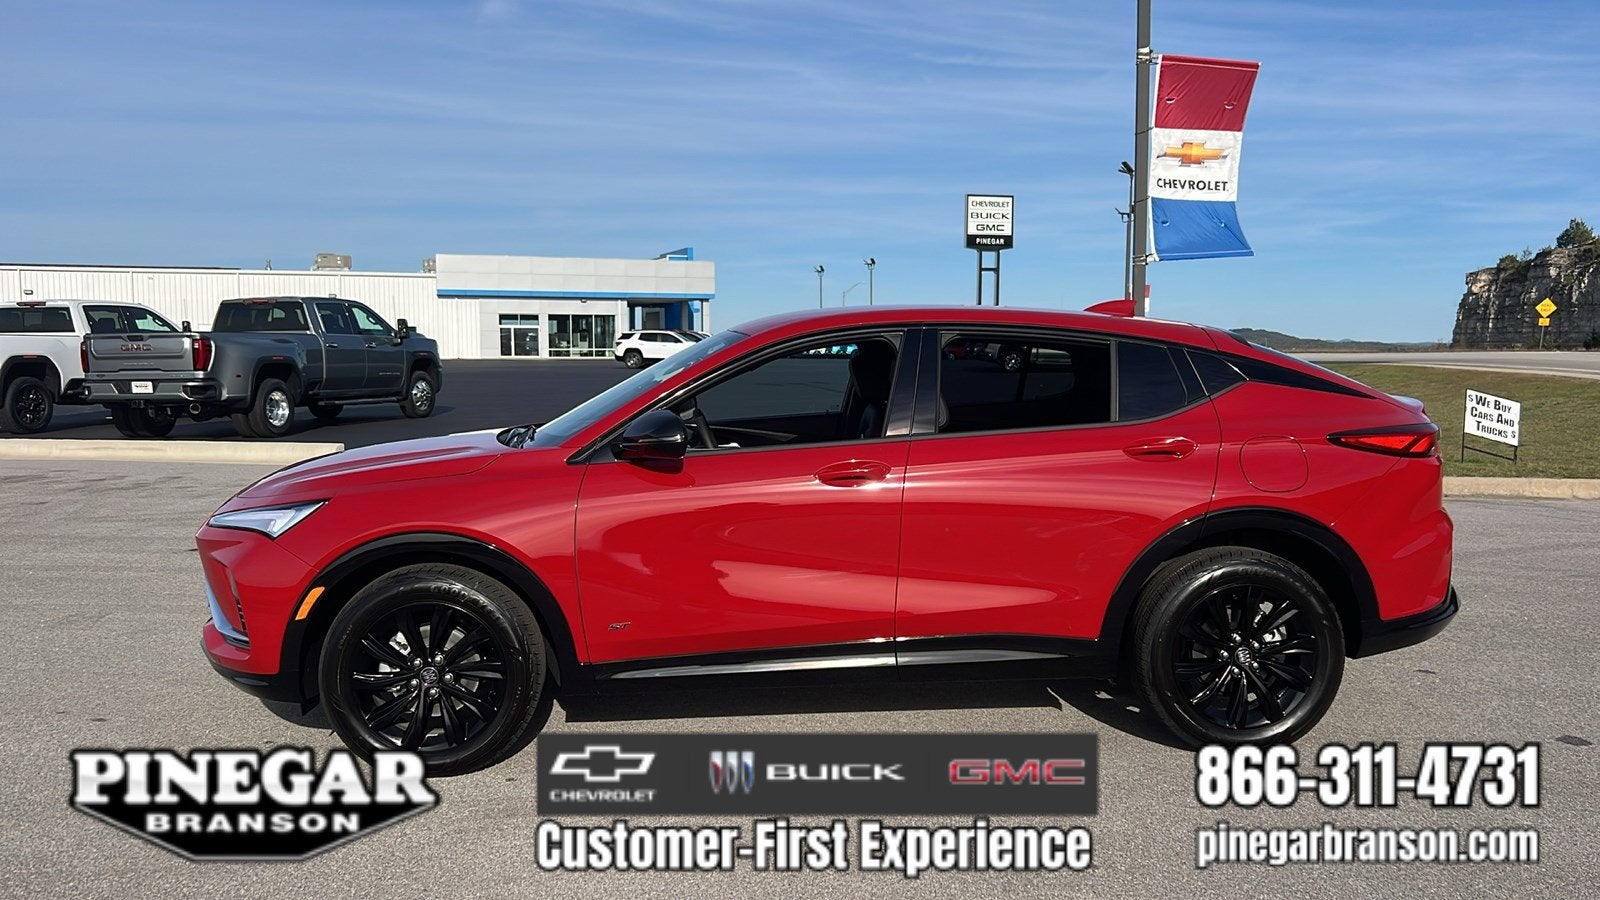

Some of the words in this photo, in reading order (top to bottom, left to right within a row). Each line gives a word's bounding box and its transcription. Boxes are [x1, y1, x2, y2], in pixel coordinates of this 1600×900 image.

[1156, 178, 1228, 191] CHEVROLET
[971, 200, 1010, 208] CHEVROLET
[970, 212, 1010, 220] BUICK
[976, 237, 1004, 245] PINEGAR
